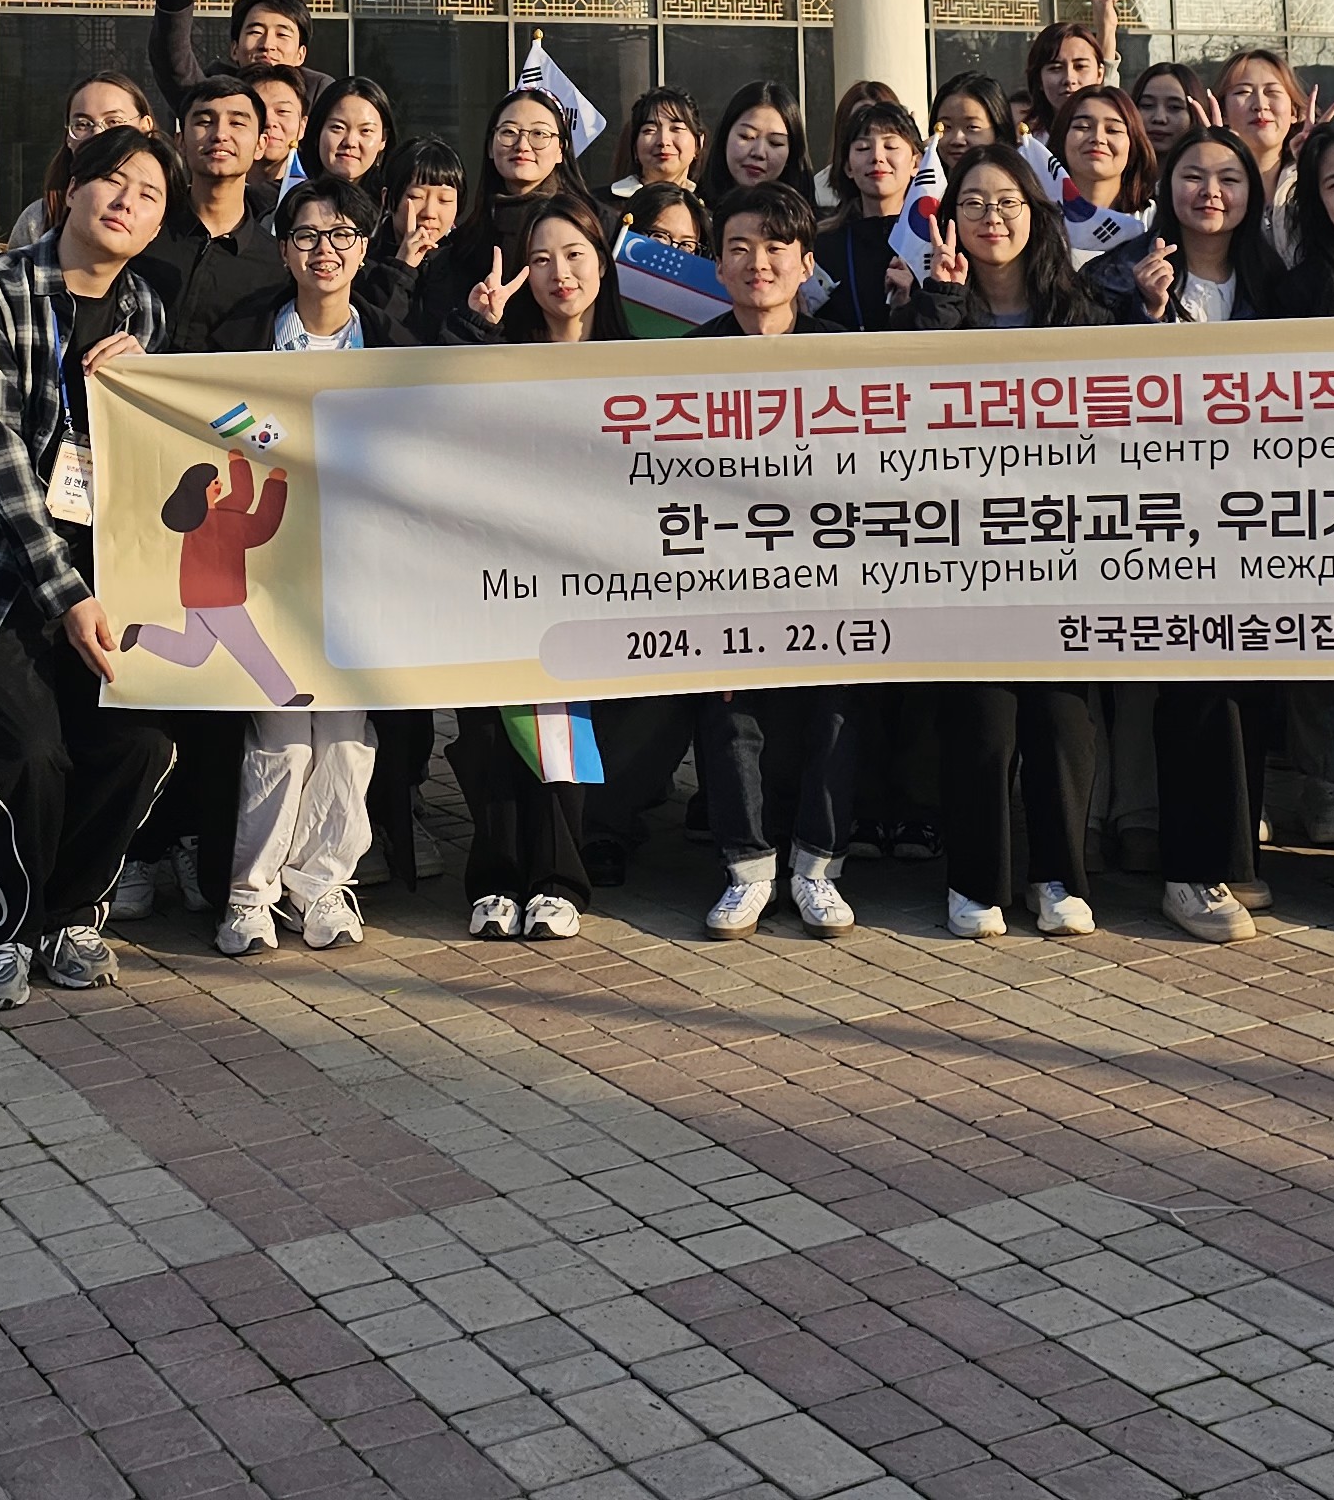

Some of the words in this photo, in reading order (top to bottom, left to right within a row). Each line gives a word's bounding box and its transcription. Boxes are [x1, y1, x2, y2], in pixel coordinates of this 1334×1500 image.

[601, 382, 912, 444] 우즈베키스탄
[927, 373, 1184, 430] 고려인들의
[628, 443, 813, 486] Духовный
[836, 452, 856, 475] и
[879, 433, 1096, 482] культурный
[1120, 439, 1230, 471] центр
[657, 502, 795, 557] 한-우
[809, 498, 960, 549] 양국의
[979, 492, 1200, 549] 문화교류,
[482, 568, 538, 601] Мы
[561, 563, 838, 603] поддерживаем
[862, 547, 1077, 594] культурный
[1100, 547, 1216, 581] обмен
[626, 629, 702, 660] 2024.
[722, 626, 765, 655] 11.
[785, 618, 891, 657] 22.(금)
